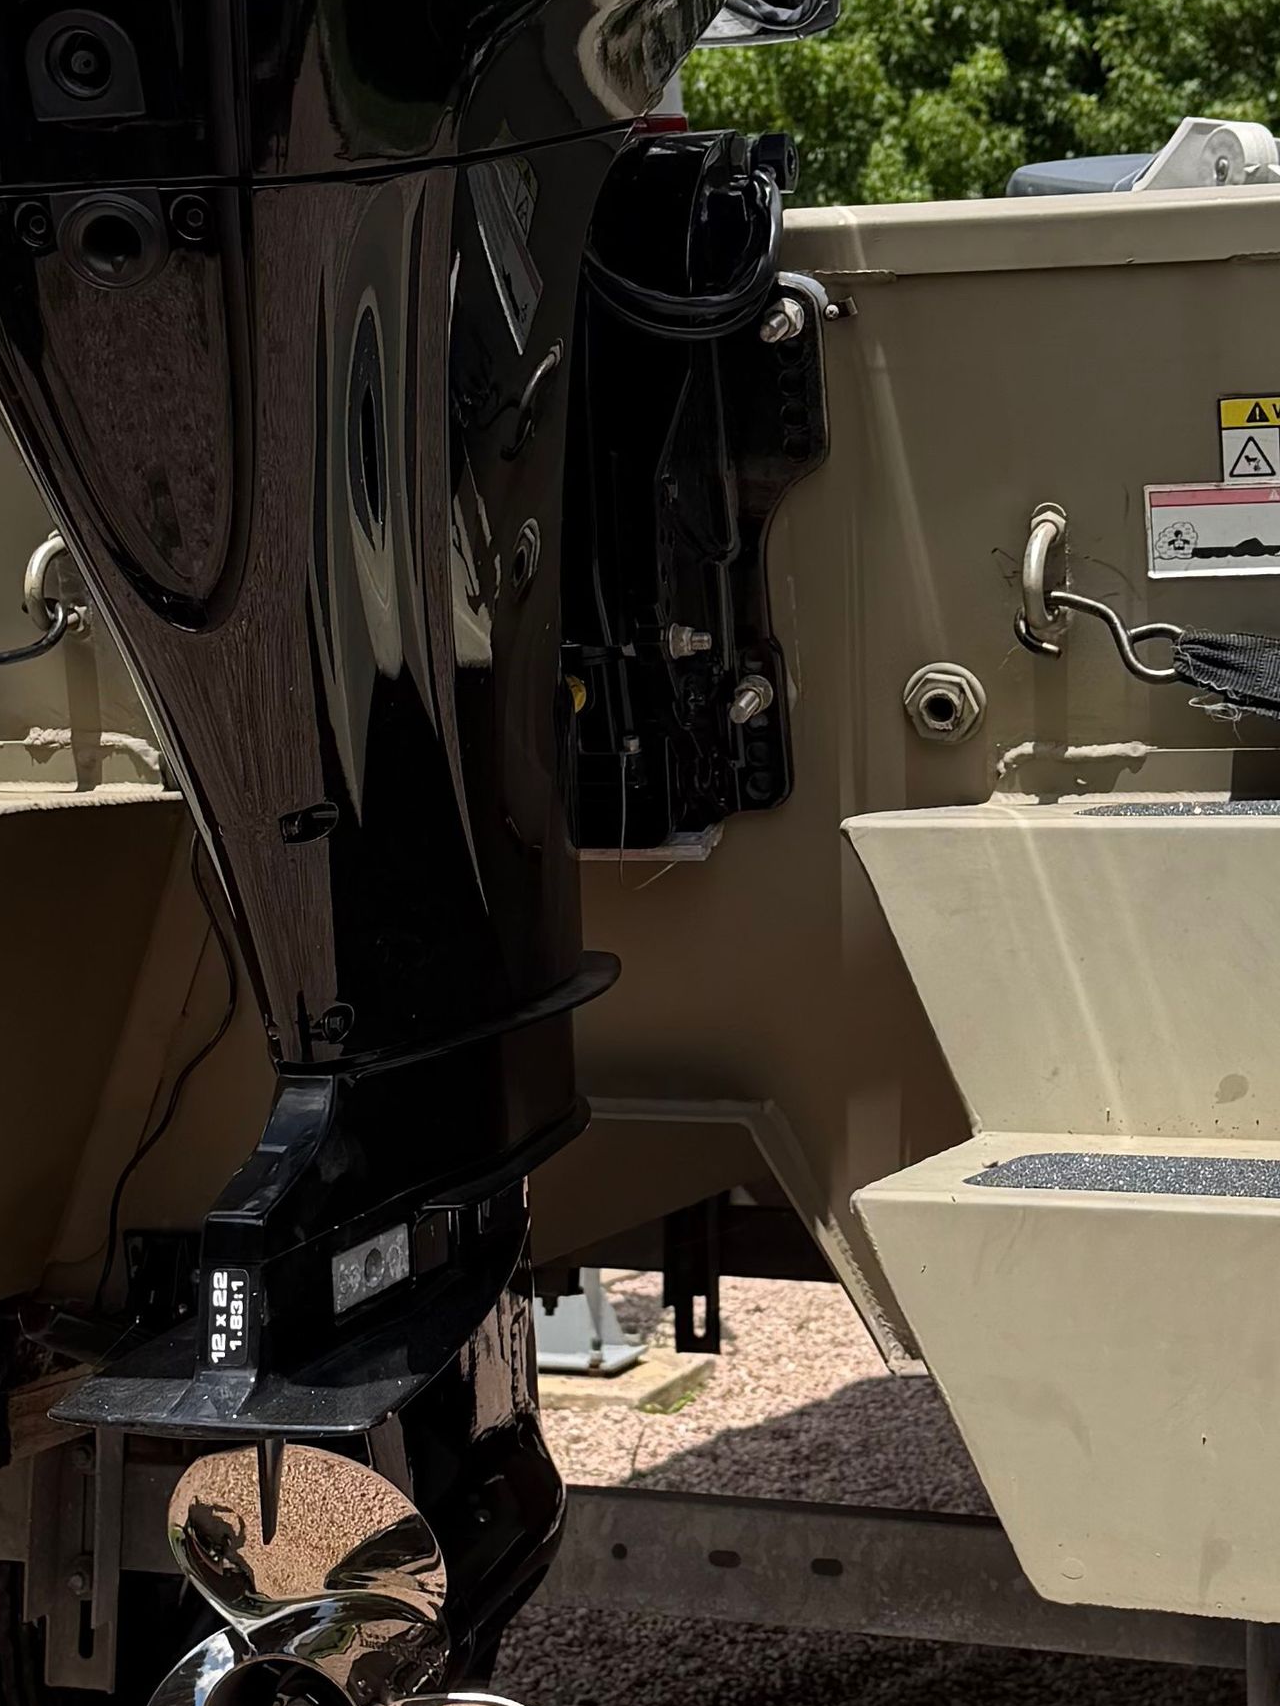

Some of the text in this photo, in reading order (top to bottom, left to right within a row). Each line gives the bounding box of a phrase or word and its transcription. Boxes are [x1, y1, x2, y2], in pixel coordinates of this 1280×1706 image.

[211, 1271, 228, 1364] 12 x 22
[229, 1280, 244, 1351] 1.83:1
